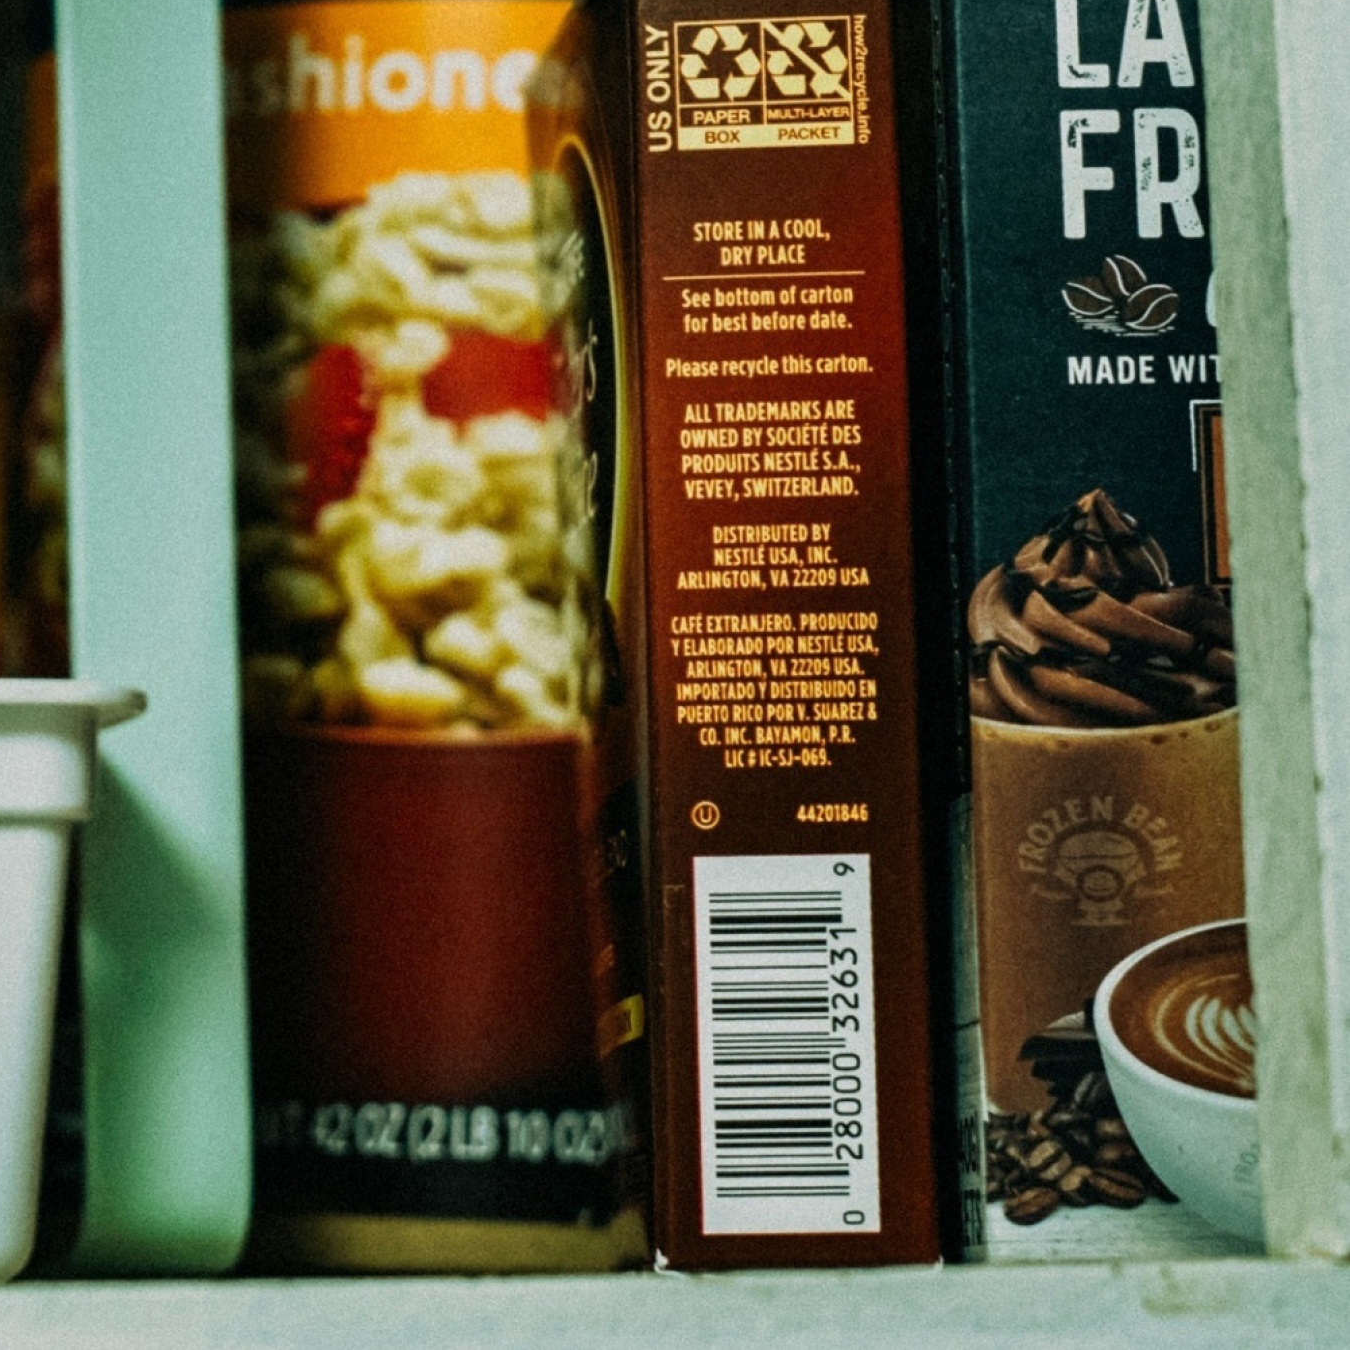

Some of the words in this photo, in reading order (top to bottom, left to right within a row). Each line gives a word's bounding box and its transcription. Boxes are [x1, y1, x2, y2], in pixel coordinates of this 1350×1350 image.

[645, 24, 671, 102] ONLY
[693, 109, 751, 124] PAPER
[767, 106, 850, 120] MULTI-LAYER
[647, 111, 673, 152] US
[704, 131, 740, 144] BOX
[778, 127, 840, 140] PACKET
[693, 221, 743, 241] STORE
[748, 220, 764, 240] IN
[768, 220, 780, 239] A
[783, 218, 831, 241] COOL,
[721, 247, 753, 266] DRY
[756, 244, 805, 265] PLACE
[681, 288, 710, 308] See
[715, 287, 775, 307] bottom
[779, 285, 797, 305] of
[800, 285, 853, 304] carton
[683, 314, 709, 333] for
[712, 313, 747, 332] best
[751, 311, 805, 331] before
[810, 311, 852, 330] date.
[665, 358, 718, 378] Please
[722, 355, 778, 378] recycle
[781, 355, 812, 374] this
[816, 354, 873, 374] carton.
[1068, 355, 1156, 386] MADE
[684, 404, 712, 423] ALL
[716, 401, 821, 423] TRADEMARKS
[825, 400, 855, 420] ARE
[680, 429, 739, 449] OWNED
[743, 428, 762, 446] BY
[767, 423, 828, 446] SOCIÉTÉ
[832, 425, 861, 444] DES
[681, 453, 760, 474] PRODUITS
[764, 449, 819, 472] NESTLÉ
[823, 451, 861, 473] S.A.,
[684, 479, 740, 501] VEVEY,
[743, 477, 859, 498] SWITZERLAND.
[713, 524, 808, 544] DISTRIBUTED
[812, 523, 831, 542] BY
[713, 545, 765, 566] NESTLÉ
[769, 547, 804, 566] USA,
[808, 546, 838, 564] INC.
[677, 570, 767, 590] ARLINGTON,
[770, 569, 789, 586] VA
[793, 568, 837, 587] 22209
[840, 567, 870, 585] USA
[671, 613, 703, 634] CAFÉ
[706, 614, 796, 633] EXTRANJERO.
[800, 612, 878, 631] PRODUCIDO
[671, 639, 680, 656] Y
[684, 638, 763, 656] ELABORADO
[767, 638, 794, 654] POR
[798, 632, 844, 653] NESTLÉ
[848, 635, 880, 655] USA,
[686, 659, 767, 679] ARLINGTON,
[770, 660, 787, 676] VA
[790, 658, 830, 676] 22209
[834, 658, 864, 675] USA.
[677, 682, 756, 701] IMPORTADO
[759, 682, 767, 699] Y
[770, 680, 856, 699] DISTRIBUIDO
[860, 679, 876, 697] EN
[677, 704, 729, 724] PUERTO
[732, 704, 763, 722] RICO
[767, 704, 794, 722] POR
[798, 703, 810, 720] V.
[813, 702, 864, 720] SUAREZ
[868, 702, 878, 720] &
[699, 728, 721, 746] CO.
[725, 727, 752, 745] INC.
[756, 725, 826, 745] BAYAMON,
[829, 725, 856, 743] P.R.
[725, 749, 745, 768] LIC
[748, 750, 756, 767] #
[759, 748, 832, 767] IC-SJ-069.
[797, 803, 869, 822] 44201846
[833, 861, 855, 877] 9
[829, 927, 861, 1032] 32631
[831, 1052, 865, 1161] 28000
[843, 1209, 866, 1226] 0
